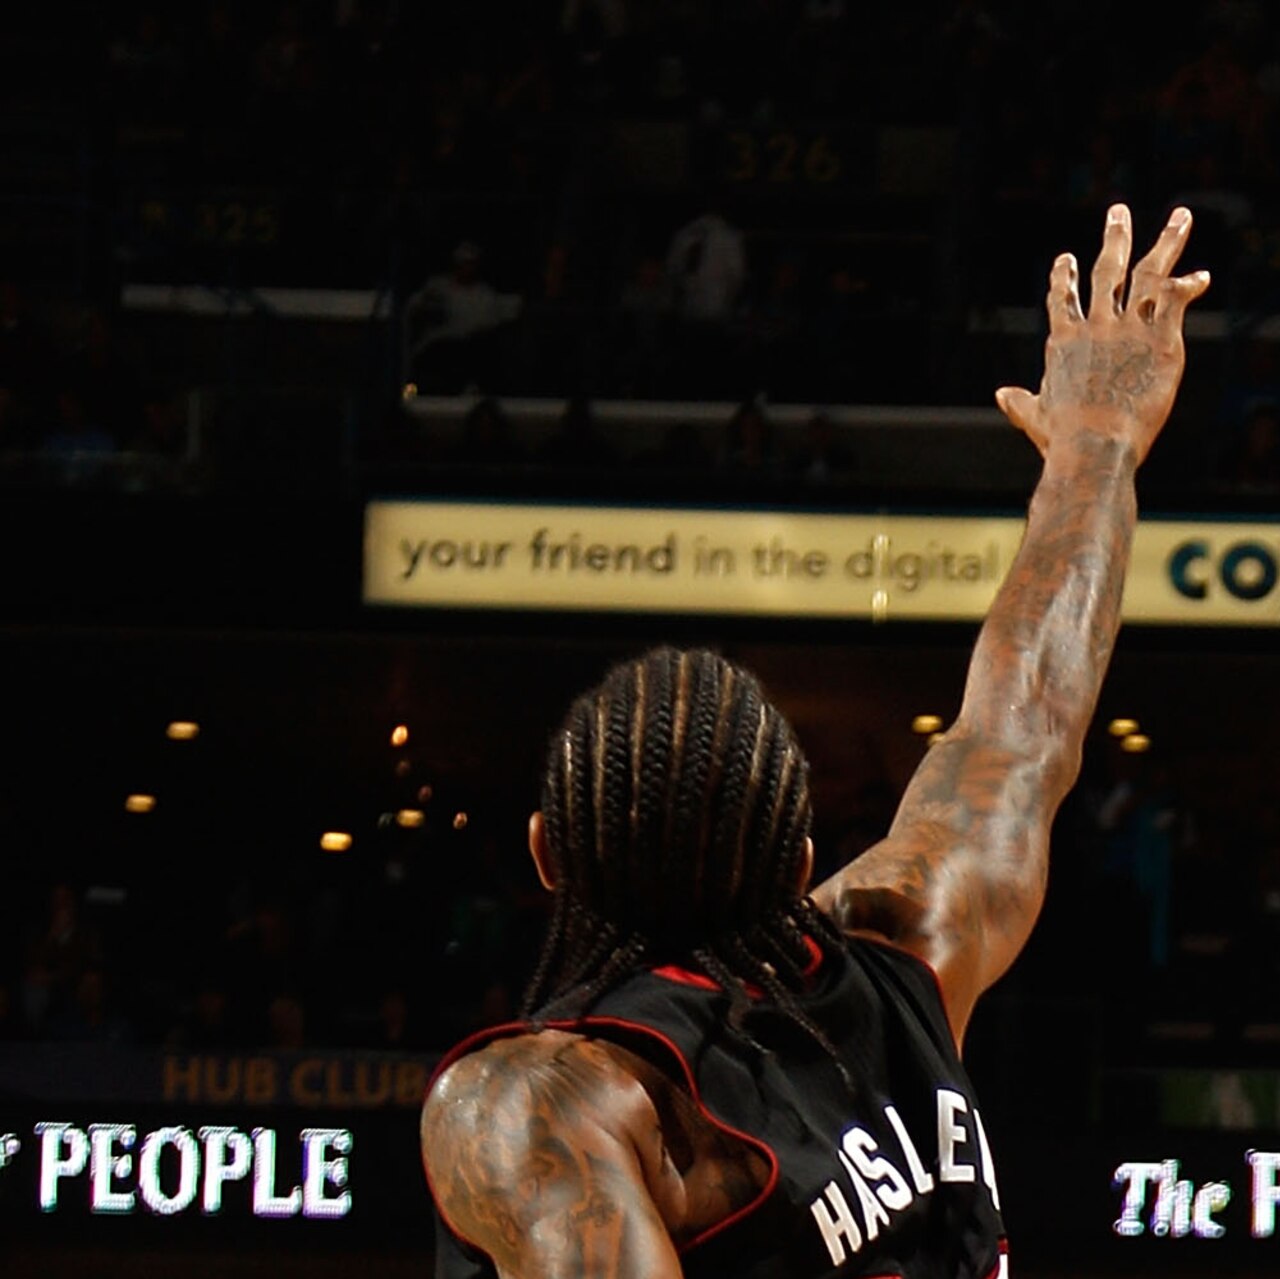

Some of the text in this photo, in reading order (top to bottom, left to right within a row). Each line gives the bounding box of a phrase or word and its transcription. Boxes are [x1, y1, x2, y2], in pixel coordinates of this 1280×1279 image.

[722, 129, 842, 184] 326
[401, 527, 1000, 592] your friend in the digital
[163, 1055, 278, 1103] HUB
[34, 1120, 356, 1220] PEOPLE
[1111, 1157, 1234, 1239] The
